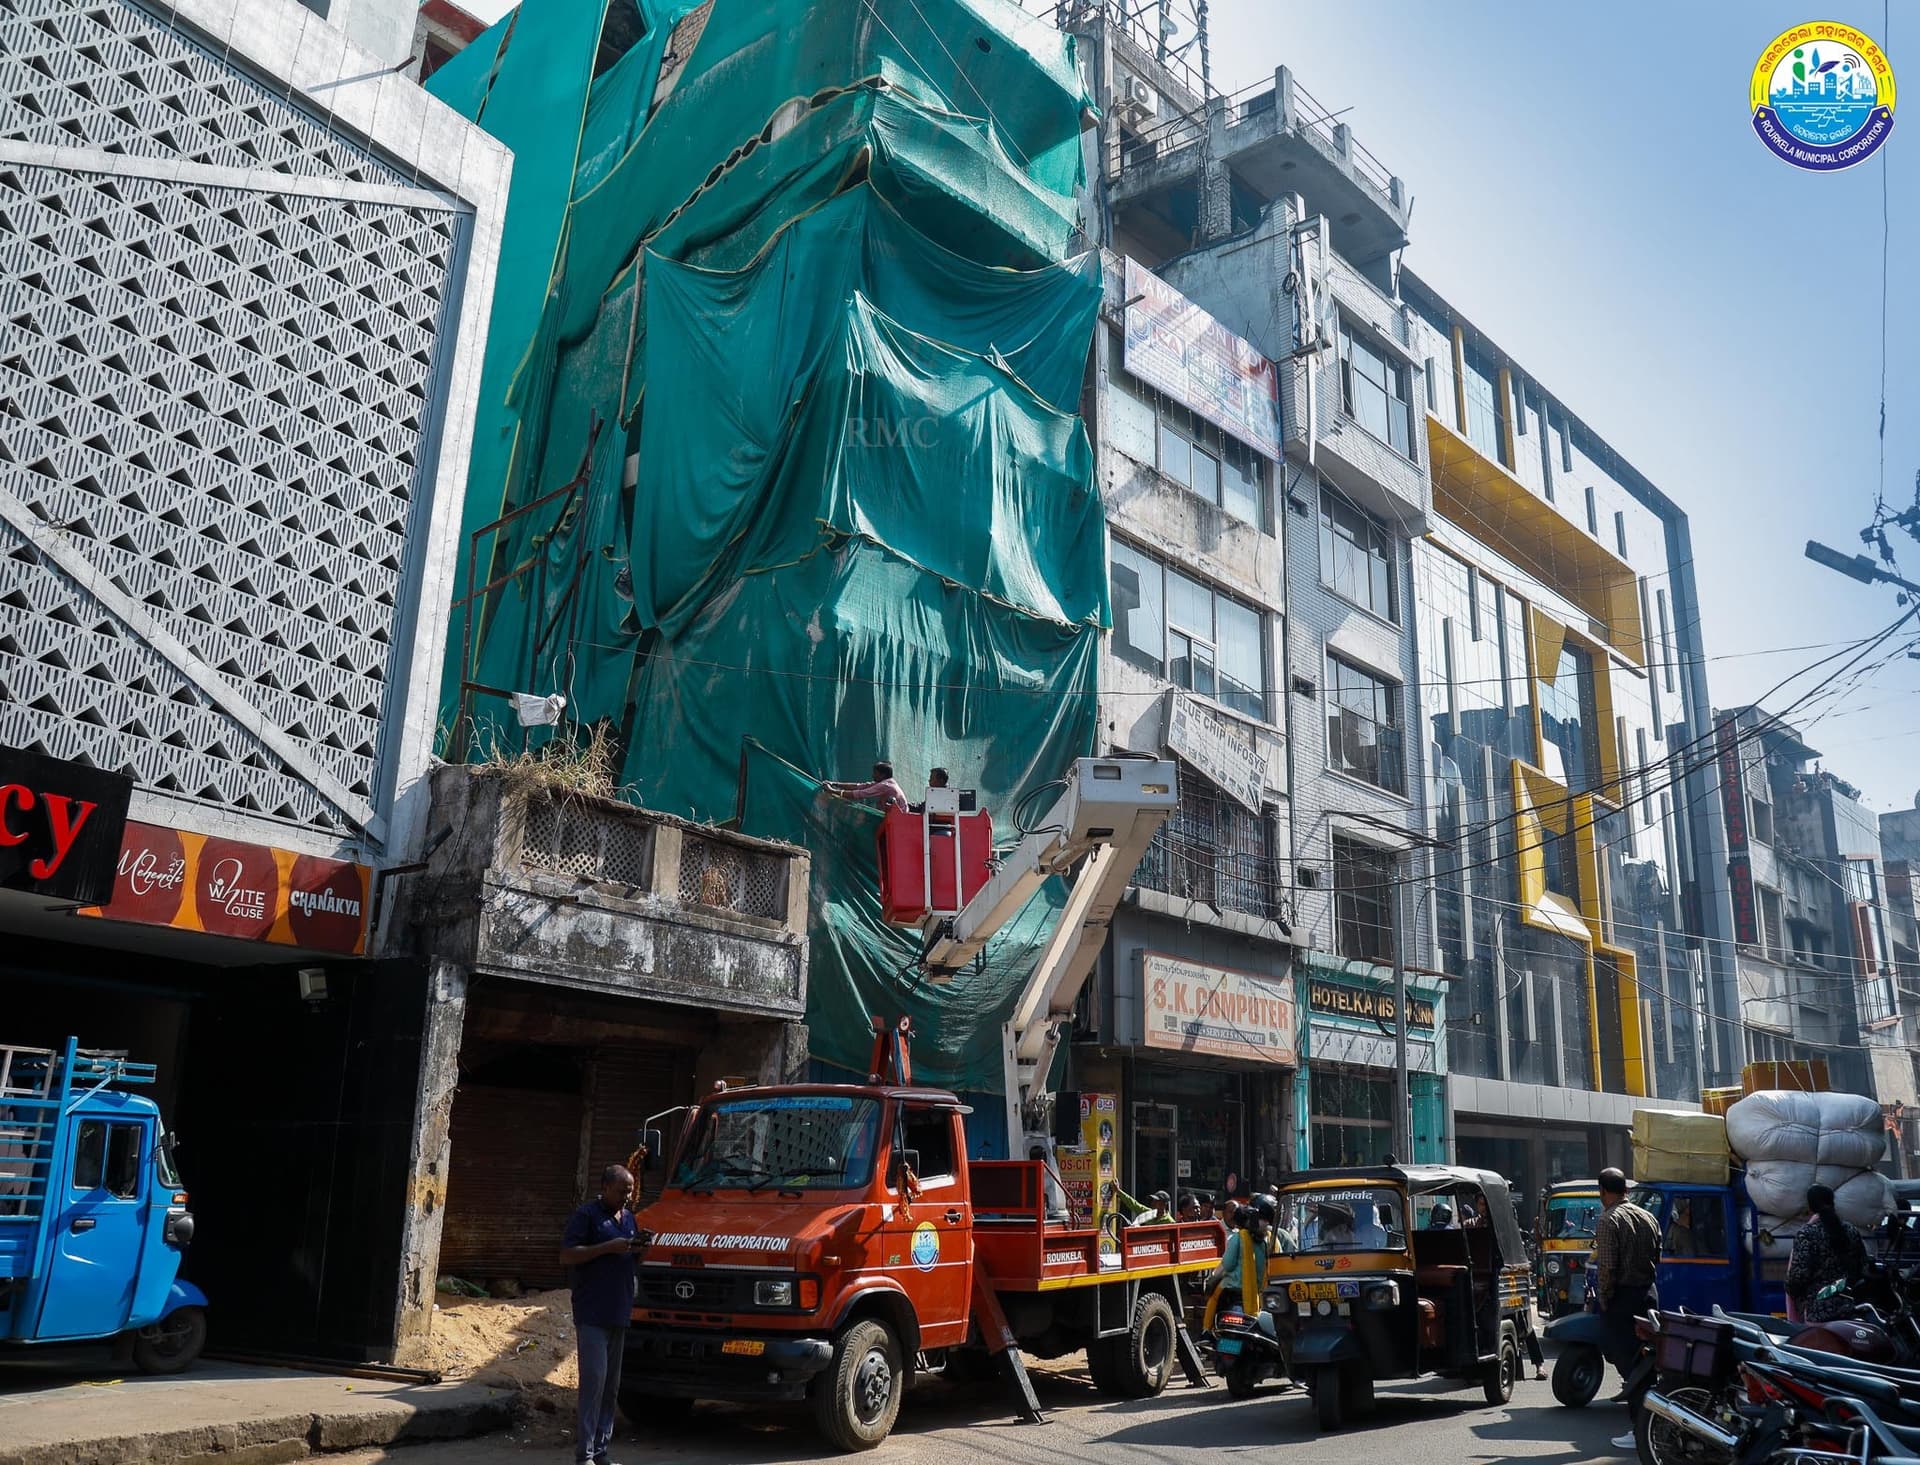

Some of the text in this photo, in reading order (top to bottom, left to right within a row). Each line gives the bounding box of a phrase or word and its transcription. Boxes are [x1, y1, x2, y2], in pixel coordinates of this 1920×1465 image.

[1176, 694, 1265, 775] BLUE CHIP INFOSYS
[290, 887, 360, 917] CHANAKYA
[1312, 984, 1353, 1011] HOTEL
[1206, 1027, 1233, 1039] SERVICES
[657, 1232, 708, 1247] MUNICIPAL
[710, 1234, 790, 1251] CORPORATION
[1046, 1251, 1082, 1264] ROURKELA
[1132, 1244, 1164, 1256] MUNICIPAL
